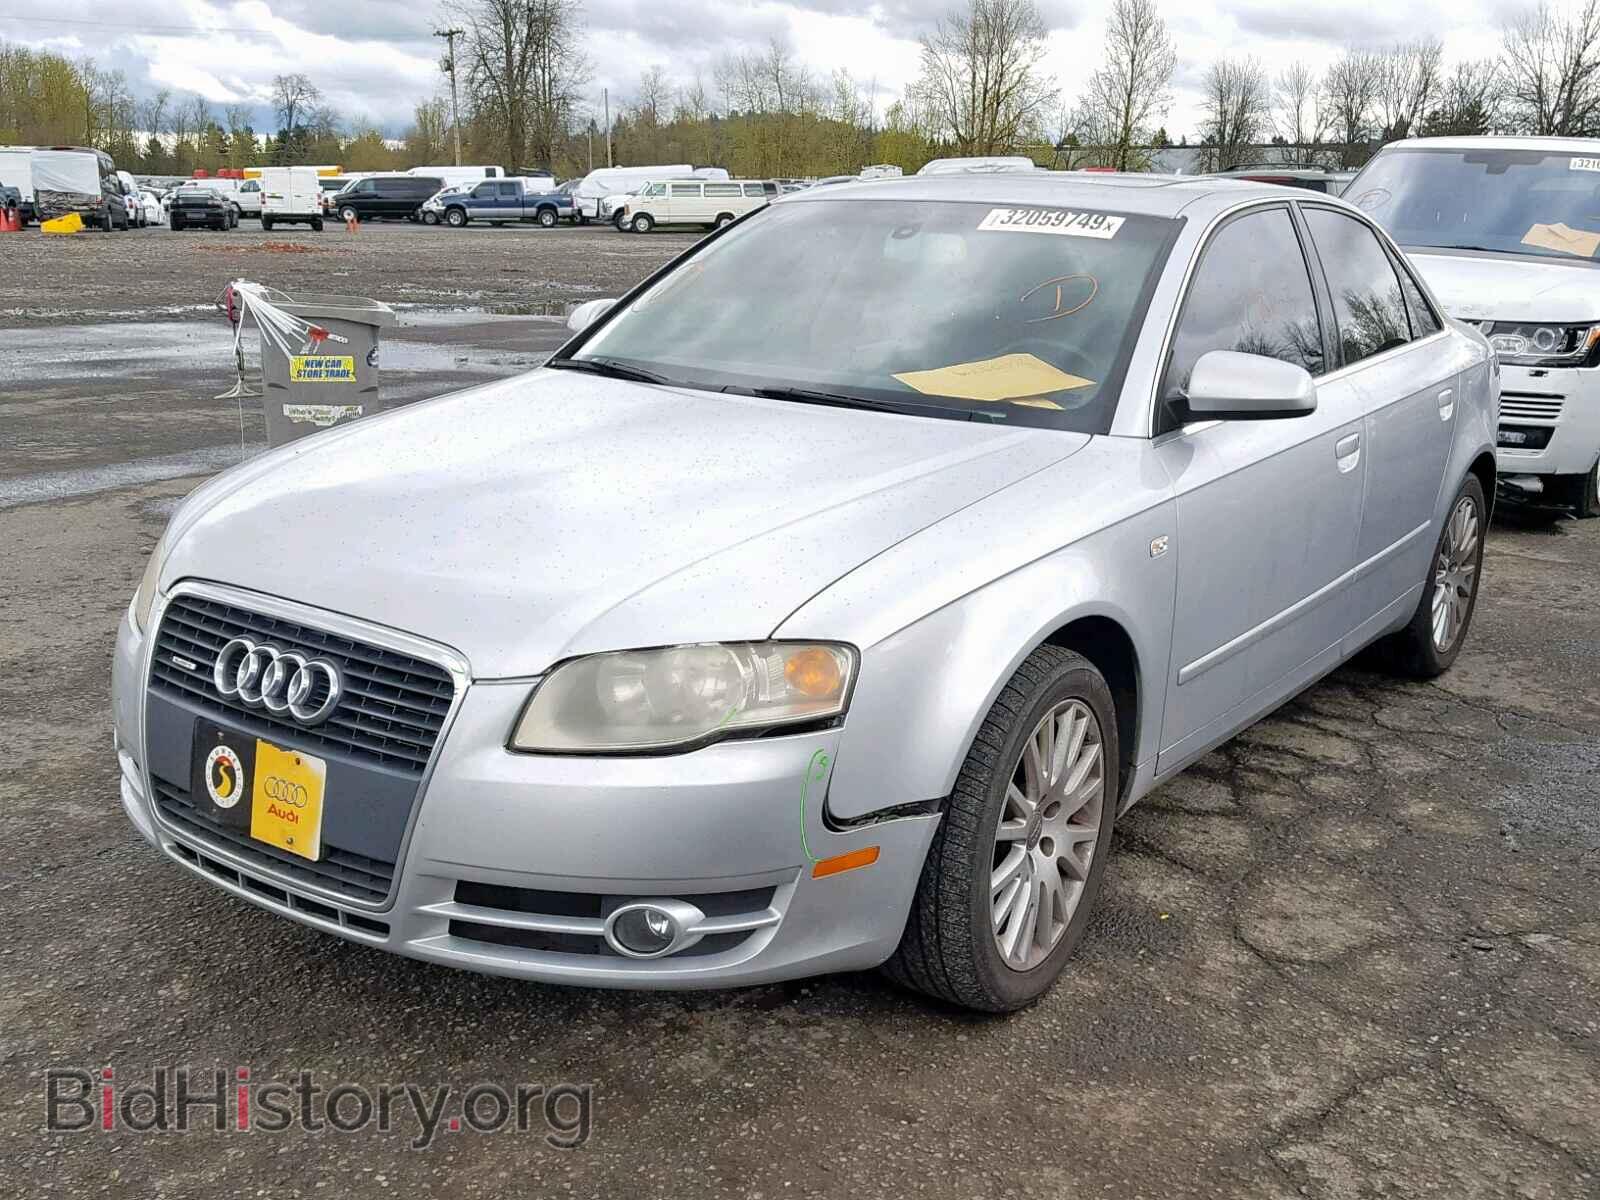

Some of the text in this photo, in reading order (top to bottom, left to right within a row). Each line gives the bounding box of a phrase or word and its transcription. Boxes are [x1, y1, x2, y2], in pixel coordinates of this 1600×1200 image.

[304, 359, 342, 369] NEW CAR
[268, 804, 299, 825] Audi
